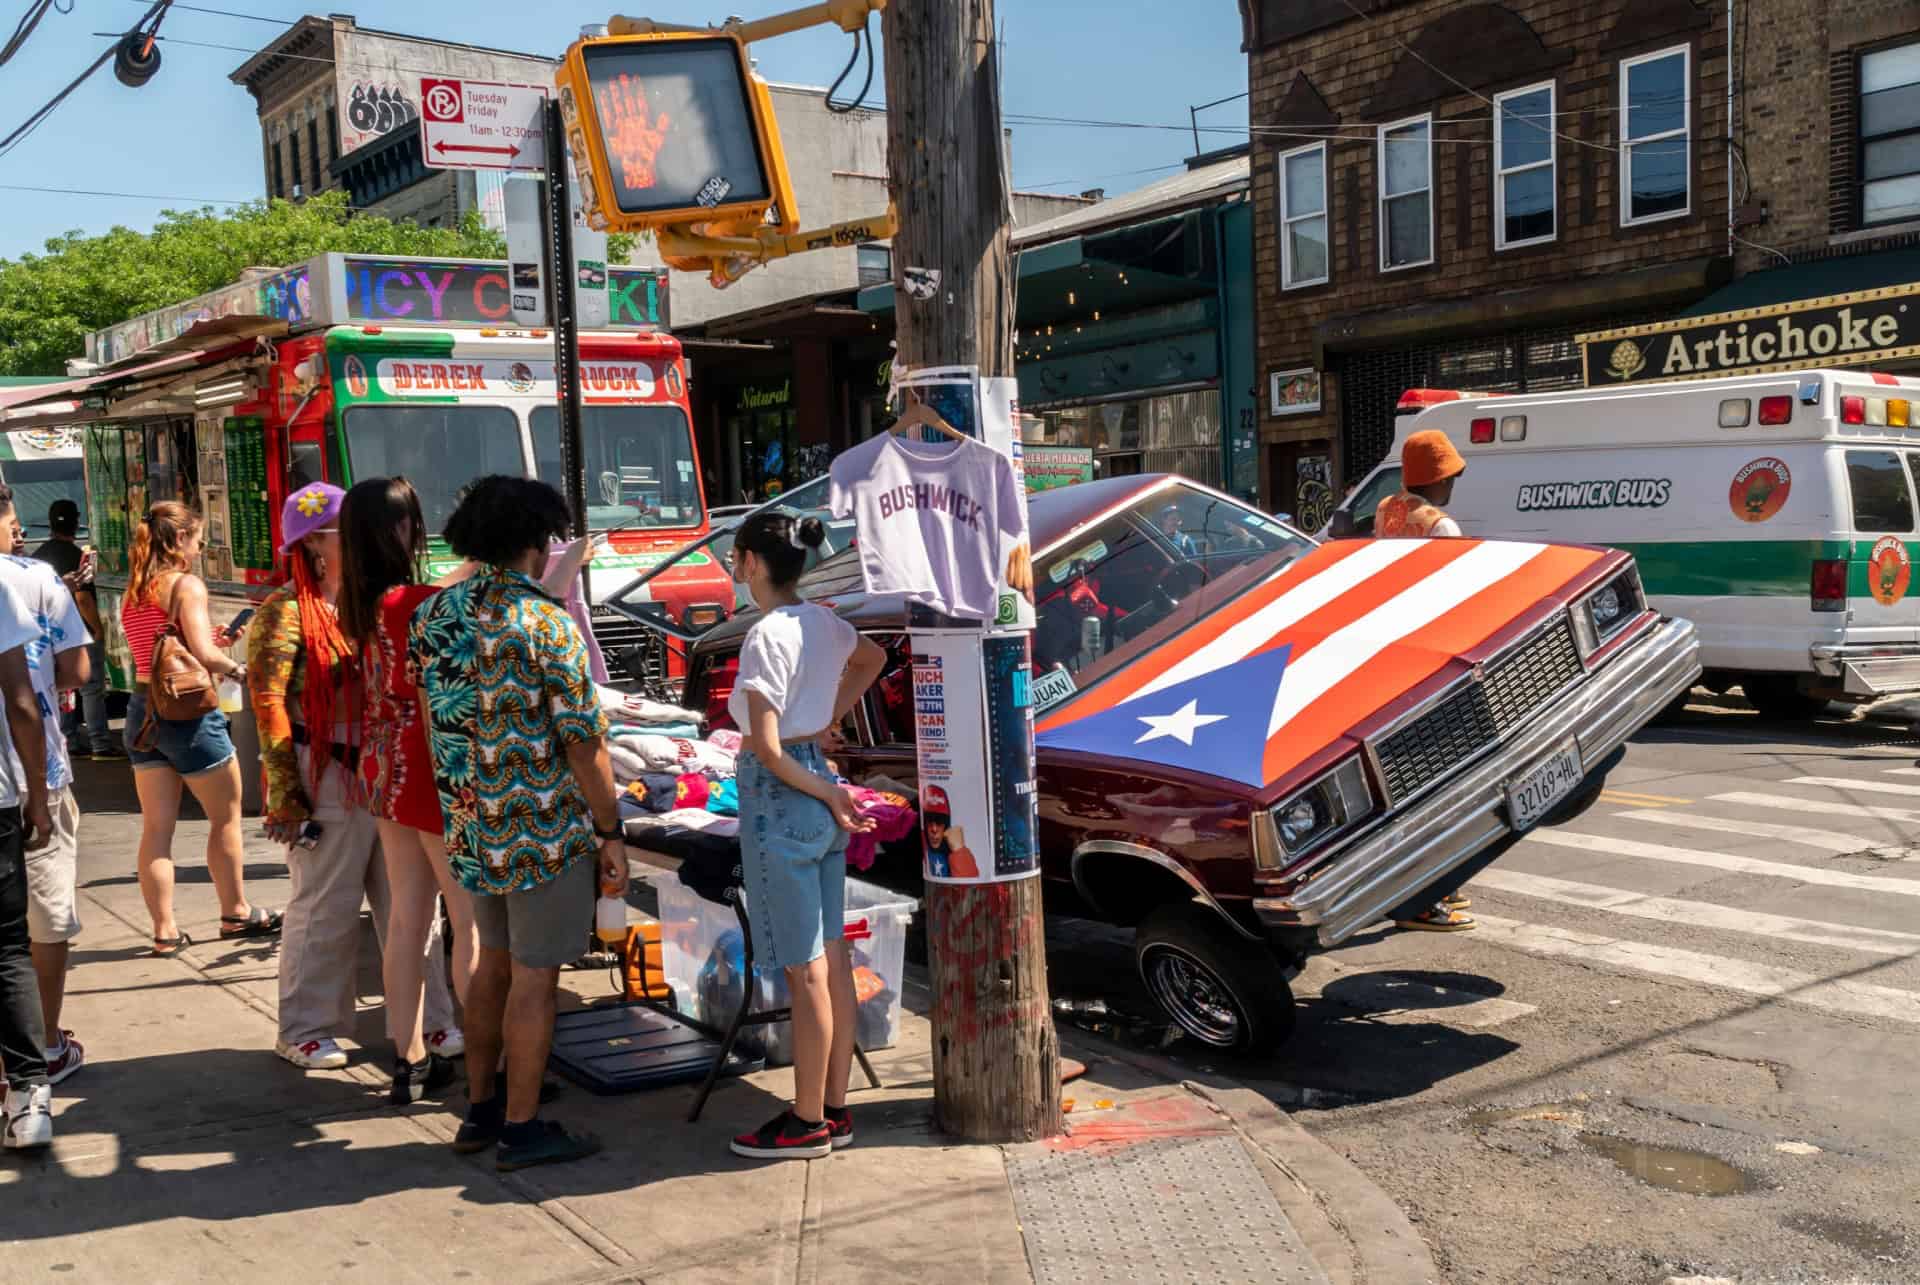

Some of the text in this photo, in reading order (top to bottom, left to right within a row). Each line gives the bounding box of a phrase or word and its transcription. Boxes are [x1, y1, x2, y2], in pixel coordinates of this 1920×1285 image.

[467, 91, 507, 104] Tuesday
[467, 104, 498, 118] Friday
[470, 124, 493, 136] 11am
[1662, 308, 1898, 374] Artichoke
[391, 363, 640, 391] DEREK RUCK
[737, 379, 790, 409] Natural
[879, 482, 983, 532] BUSHWICK
[1516, 479, 1674, 510] BUSHWICK BUDS
[1033, 678, 1068, 705] JUAN
